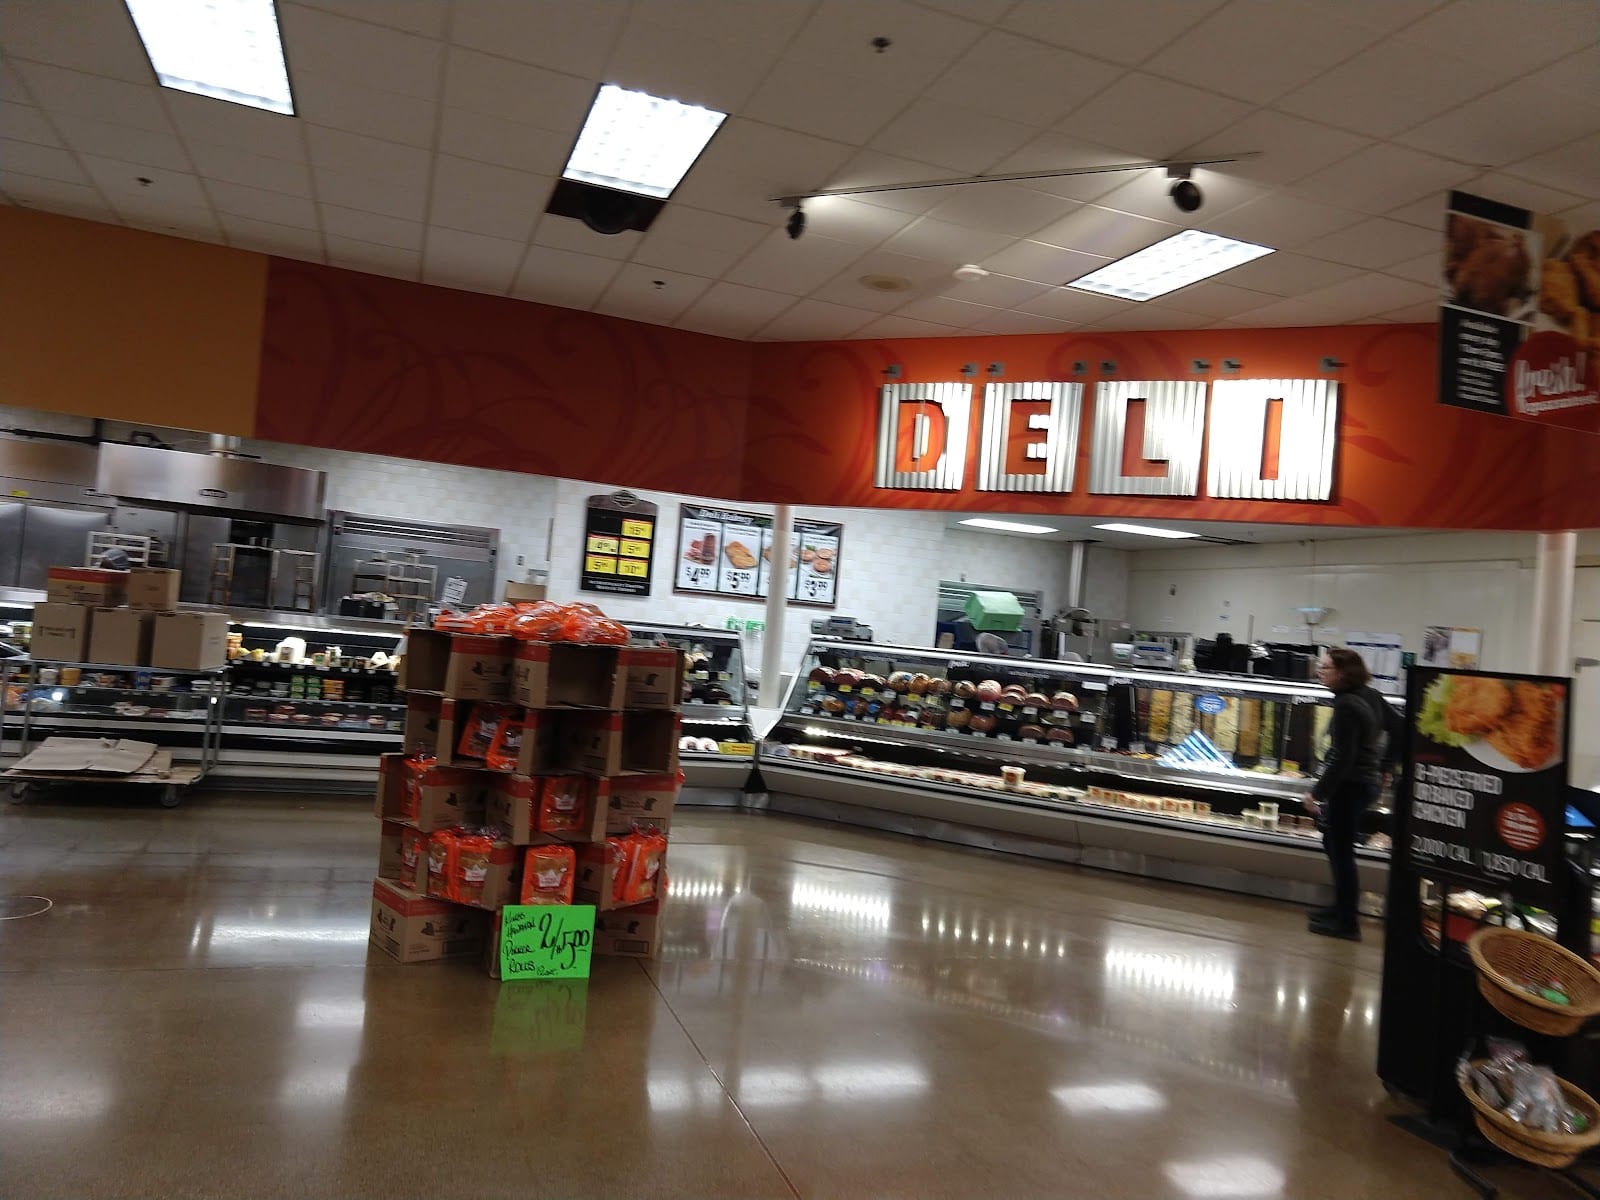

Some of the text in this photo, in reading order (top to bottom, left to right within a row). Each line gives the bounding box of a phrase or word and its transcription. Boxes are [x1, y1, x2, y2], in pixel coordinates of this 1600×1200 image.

[892, 395, 1289, 485] DELI
[1411, 799, 1467, 830] CHICKEN
[1447, 841, 1477, 866] CAL
[1520, 860, 1553, 885] CAL
